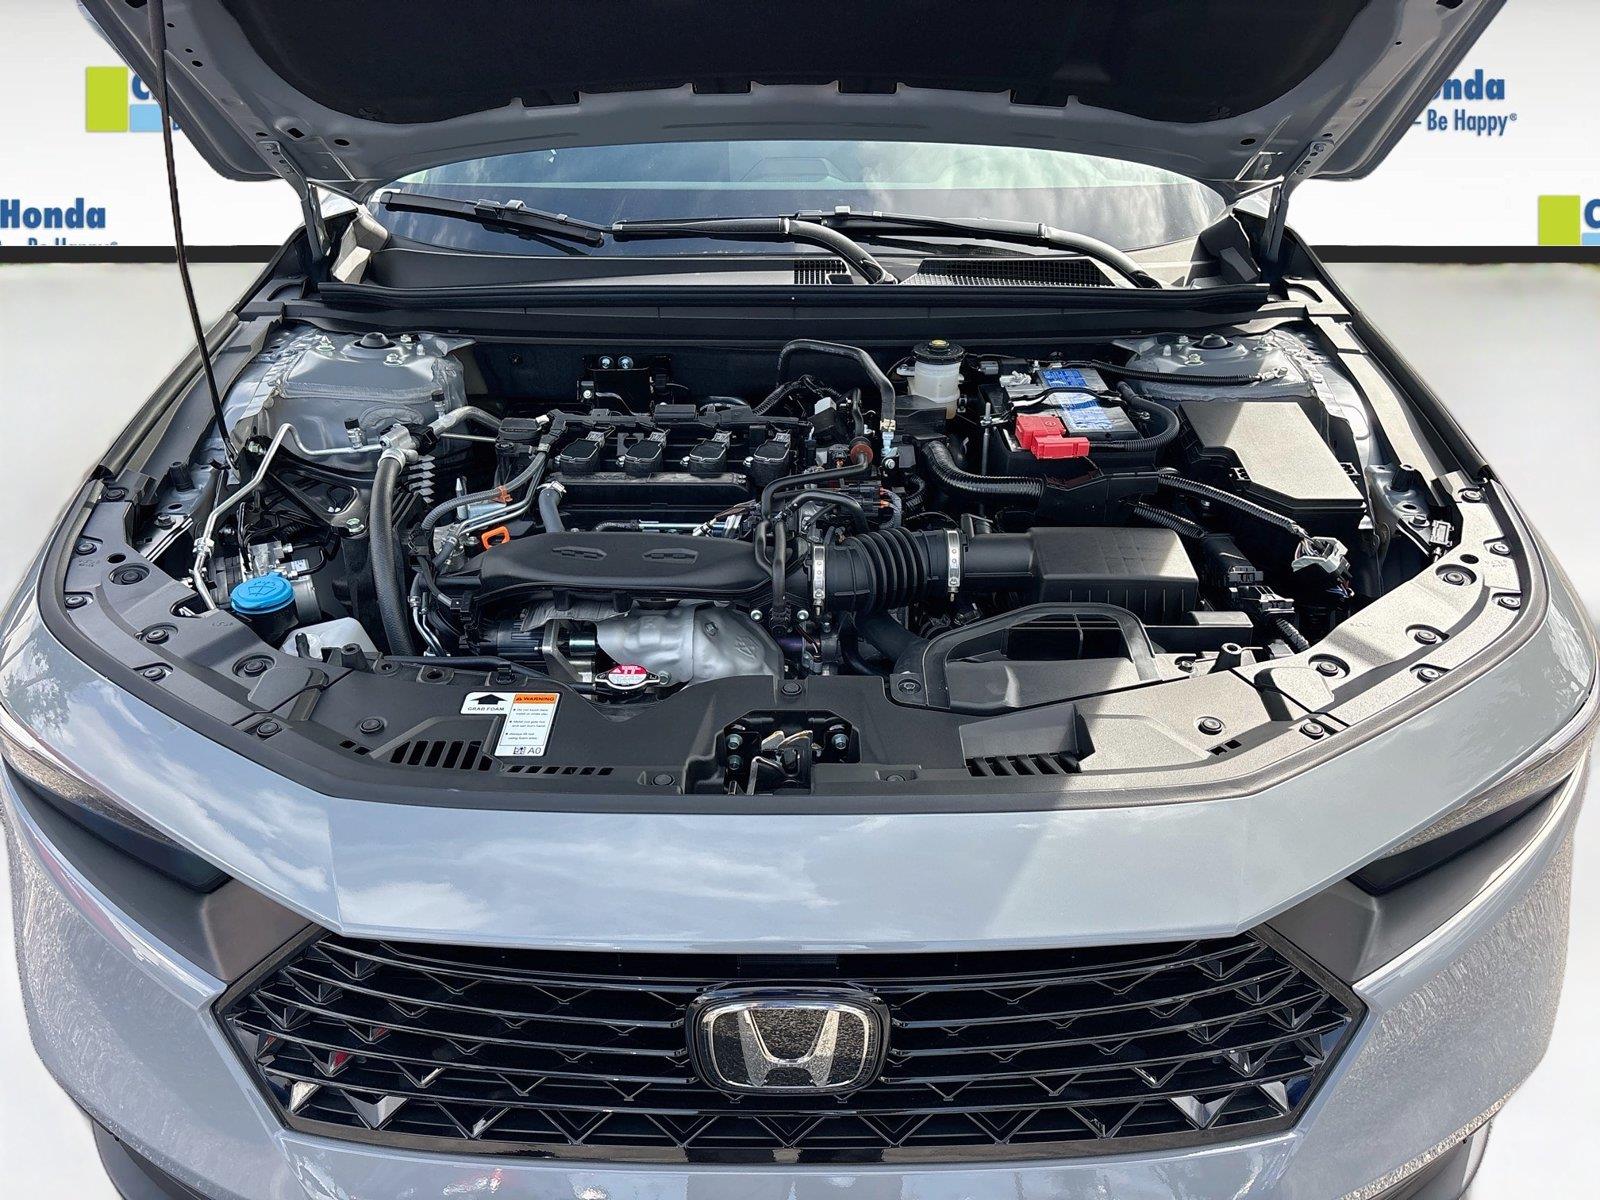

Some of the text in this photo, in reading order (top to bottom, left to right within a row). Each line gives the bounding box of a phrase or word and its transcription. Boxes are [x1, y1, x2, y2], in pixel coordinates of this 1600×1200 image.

[1432, 68, 1505, 100] nda
[1427, 109, 1448, 131] Be
[0, 197, 106, 229] Honda
